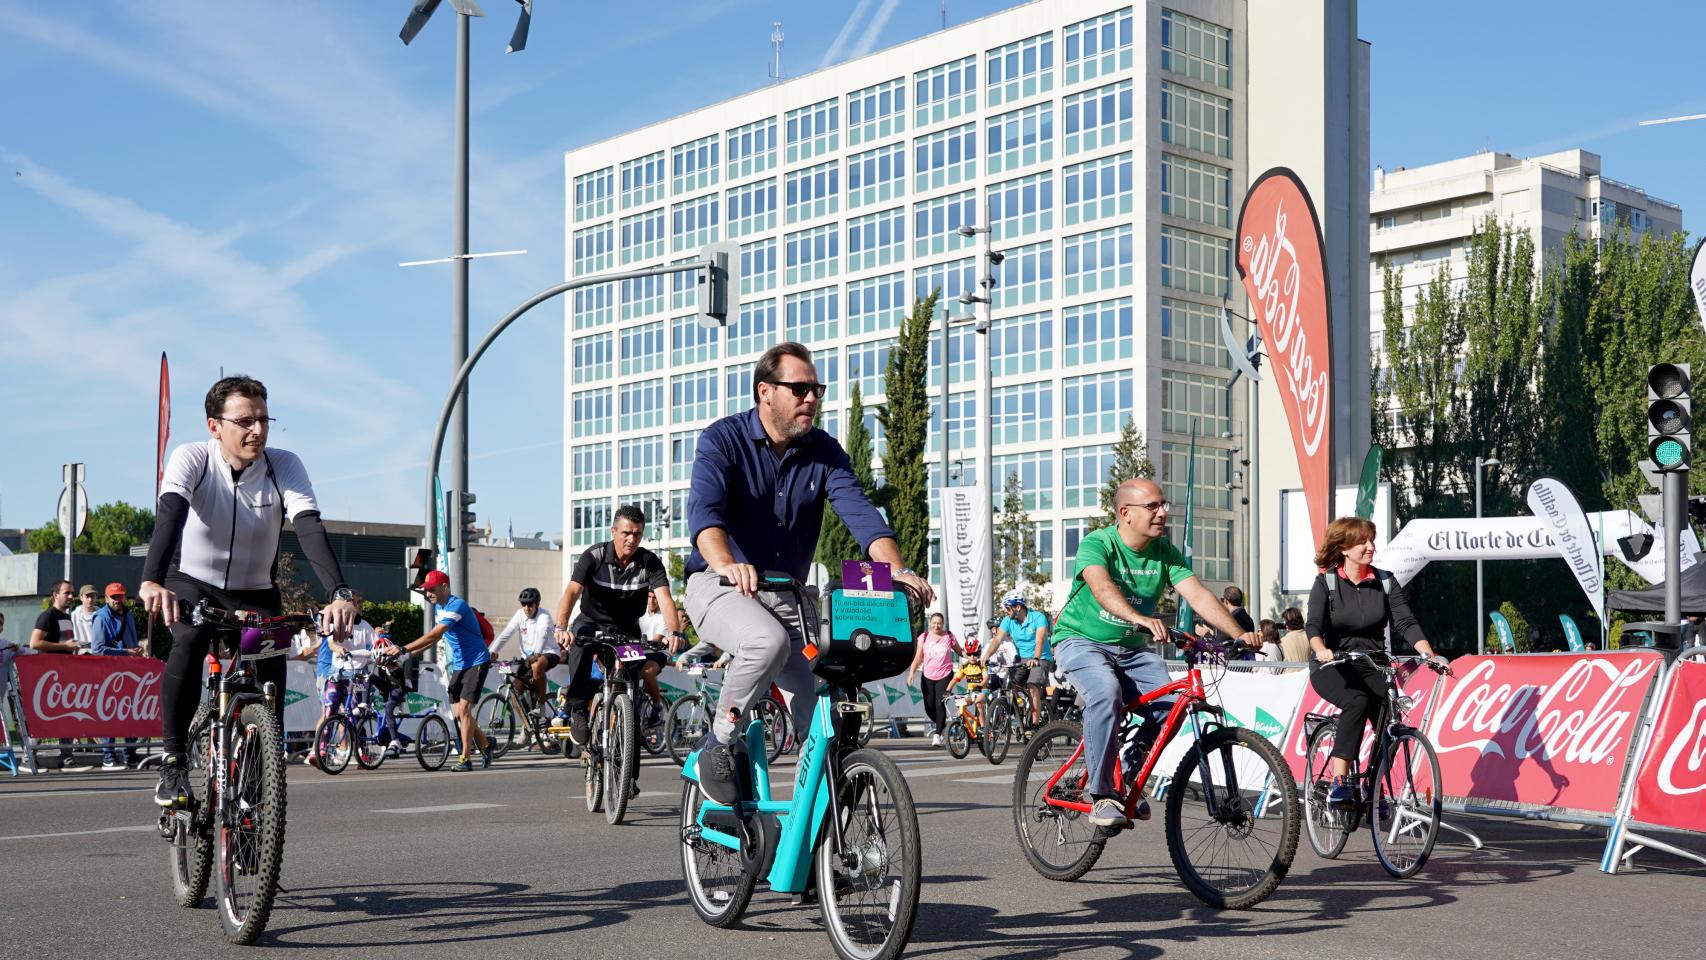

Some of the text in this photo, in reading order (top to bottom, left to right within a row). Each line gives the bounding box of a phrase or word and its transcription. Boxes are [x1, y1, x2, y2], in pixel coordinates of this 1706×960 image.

[1428, 530, 1450, 550] El
[1455, 530, 1501, 550] Norte
[1505, 530, 1524, 549] de
[861, 574, 874, 591] 1
[259, 639, 275, 653] 2
[33, 670, 161, 721] Coca-Cola
[1425, 658, 1657, 764] Coca-Cola
[799, 735, 816, 789] BIKI
